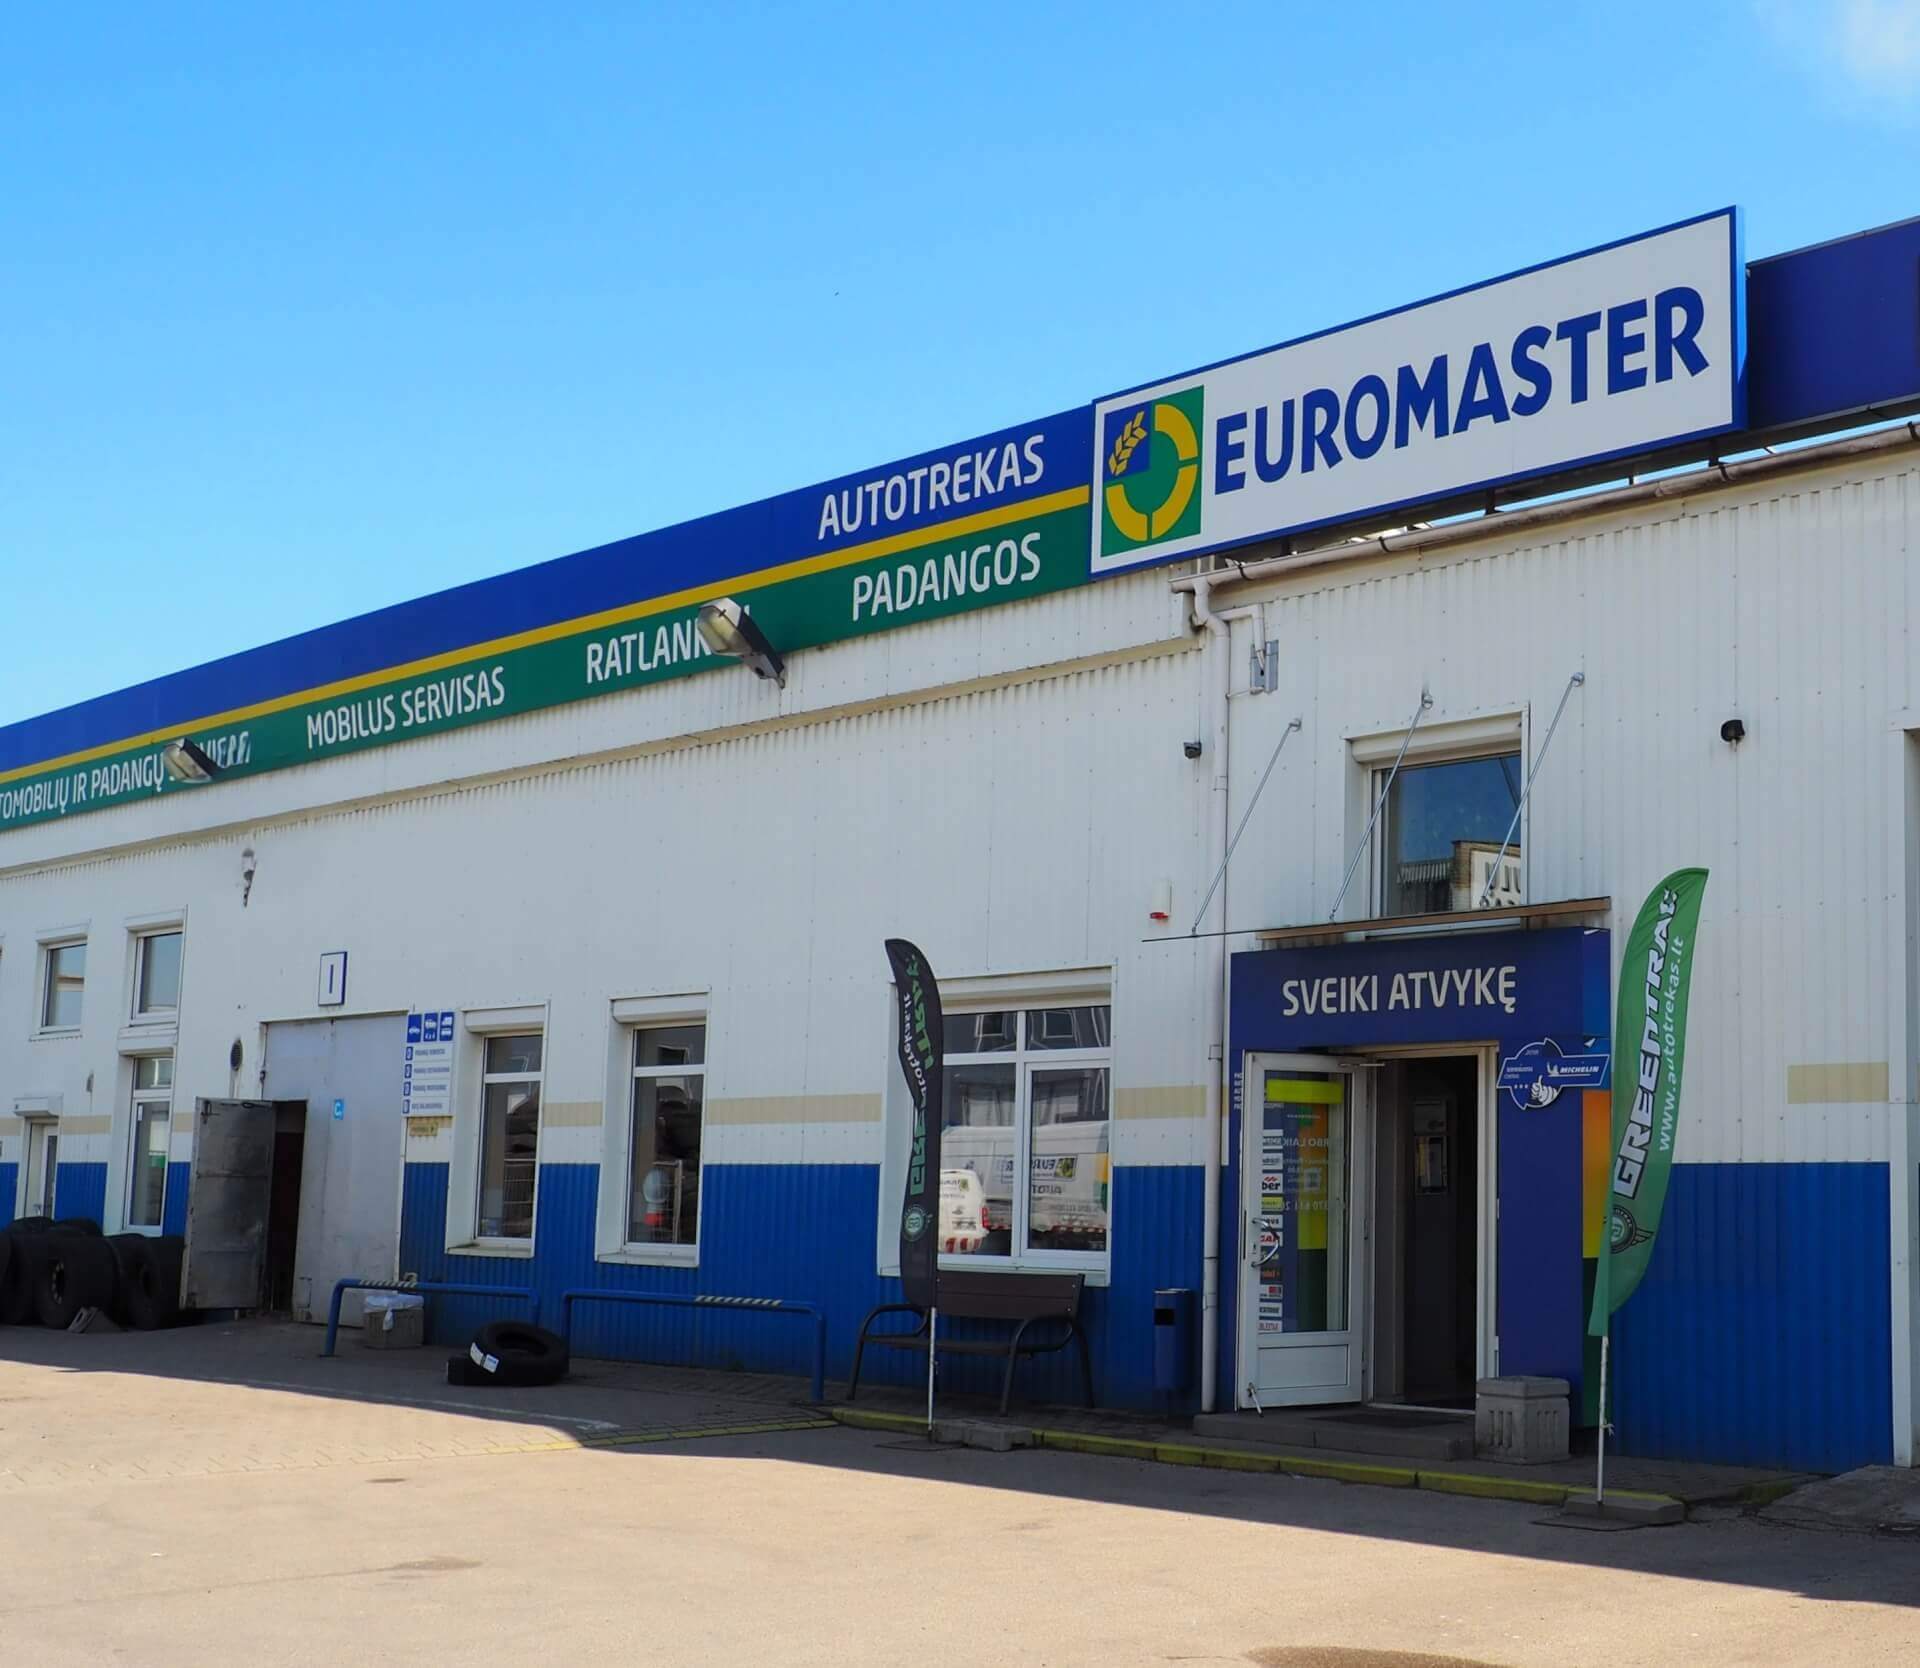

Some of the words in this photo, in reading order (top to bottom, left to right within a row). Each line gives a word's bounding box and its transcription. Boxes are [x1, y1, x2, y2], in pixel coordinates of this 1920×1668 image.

[1214, 285, 1710, 495] EUROMASTER
[818, 434, 1045, 541] AUTOTREKAS
[852, 532, 1041, 621] PADANGOS
[587, 605, 750, 684] RATLANK
[307, 695, 396, 750] MOBILUS
[401, 666, 506, 727] SERVISAS
[72, 771, 86, 804] IR
[91, 752, 164, 793] PADANGŲ
[1282, 972, 1378, 1017] SVEIKI
[1388, 965, 1517, 1014] ATVYKĘ
[1560, 1065, 1600, 1073] MICHELIN
[1659, 935, 1684, 1151] www.autotrekas.lt
